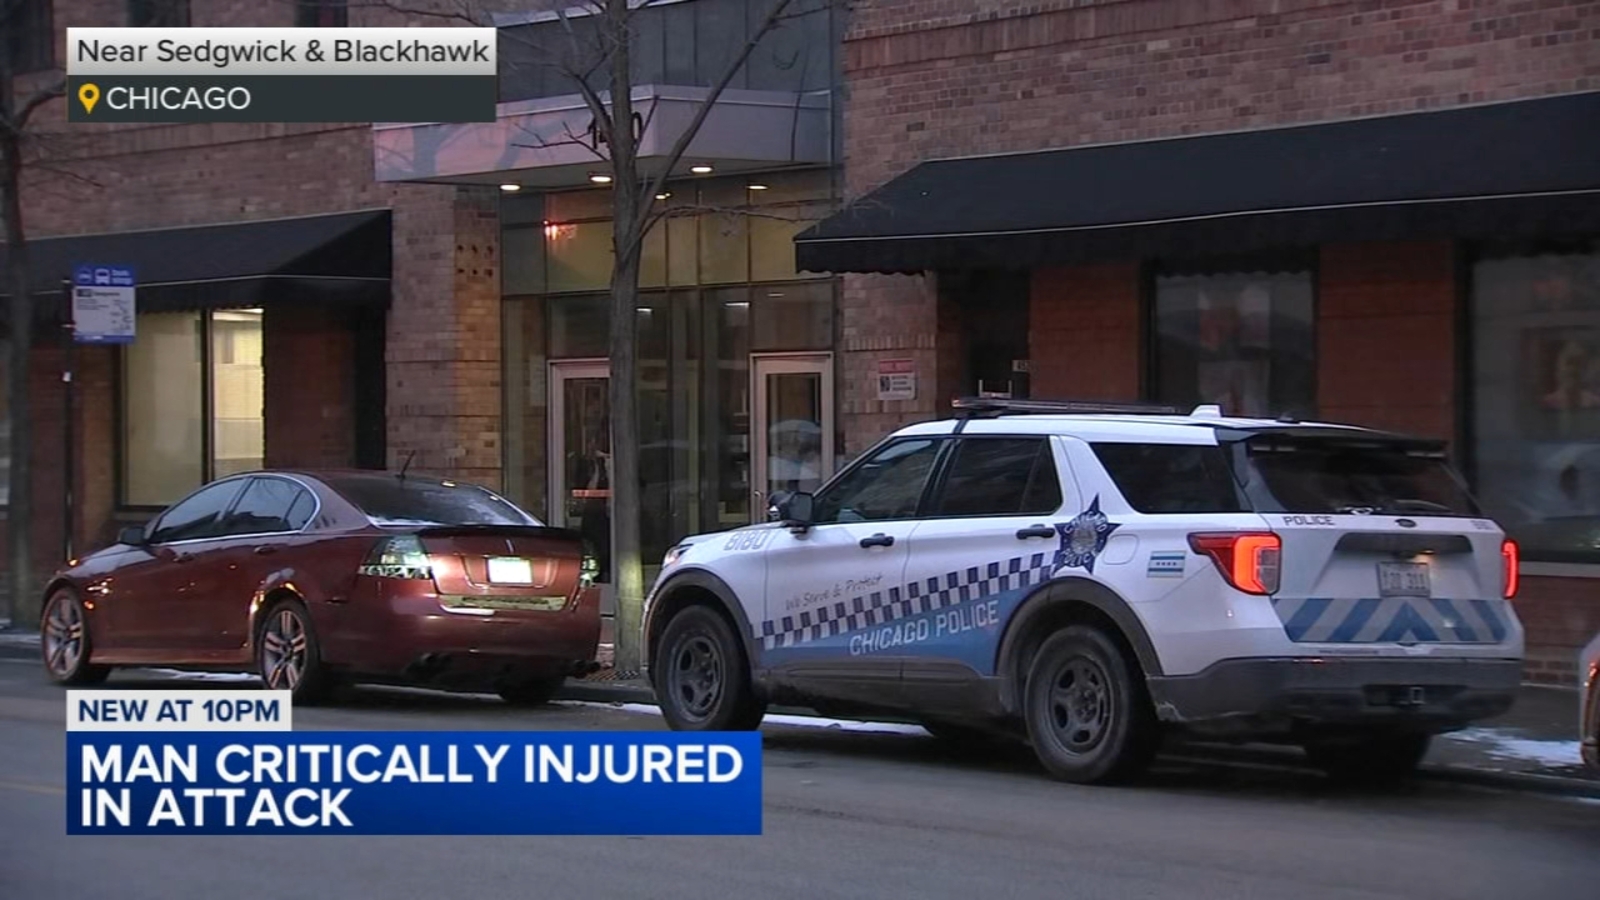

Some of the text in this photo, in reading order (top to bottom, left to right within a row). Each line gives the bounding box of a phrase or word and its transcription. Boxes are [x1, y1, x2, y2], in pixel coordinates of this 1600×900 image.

[1282, 515, 1335, 527] POLICE
[850, 600, 1000, 656] CHICAGO POLICE
